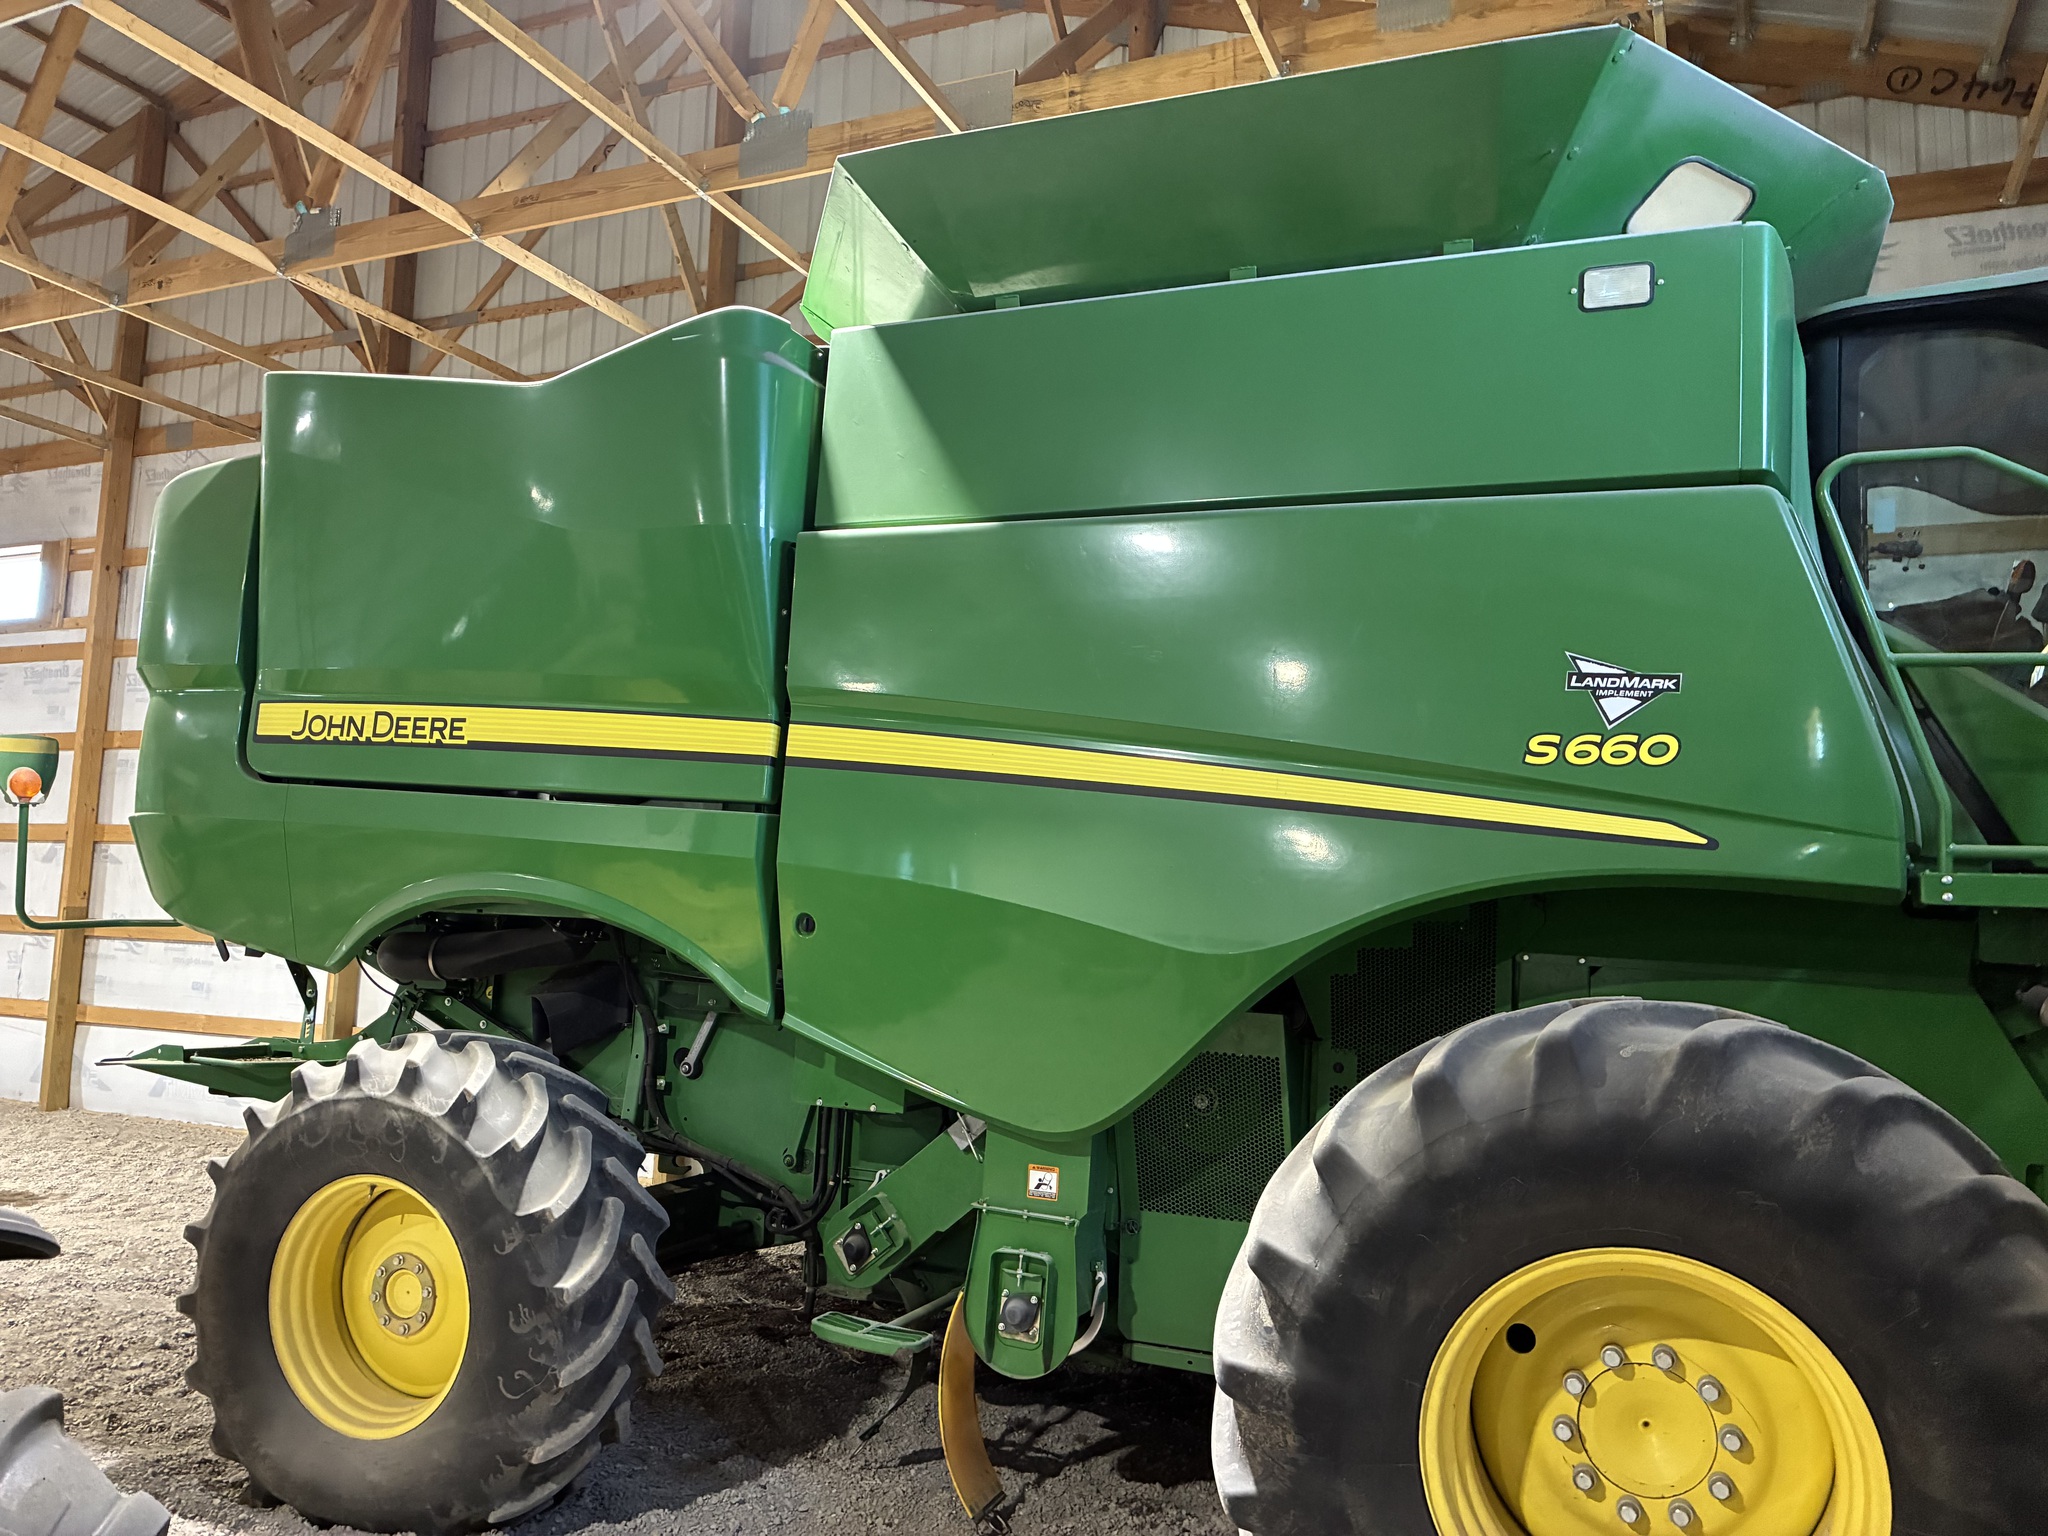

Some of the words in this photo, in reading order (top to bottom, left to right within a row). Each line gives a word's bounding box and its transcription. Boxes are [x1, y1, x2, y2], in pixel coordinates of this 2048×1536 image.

[1595, 689, 1654, 698] IMPLEMENT
[291, 709, 366, 738] JOHN
[372, 710, 467, 741] DEERE
[1522, 732, 1681, 766] S660
